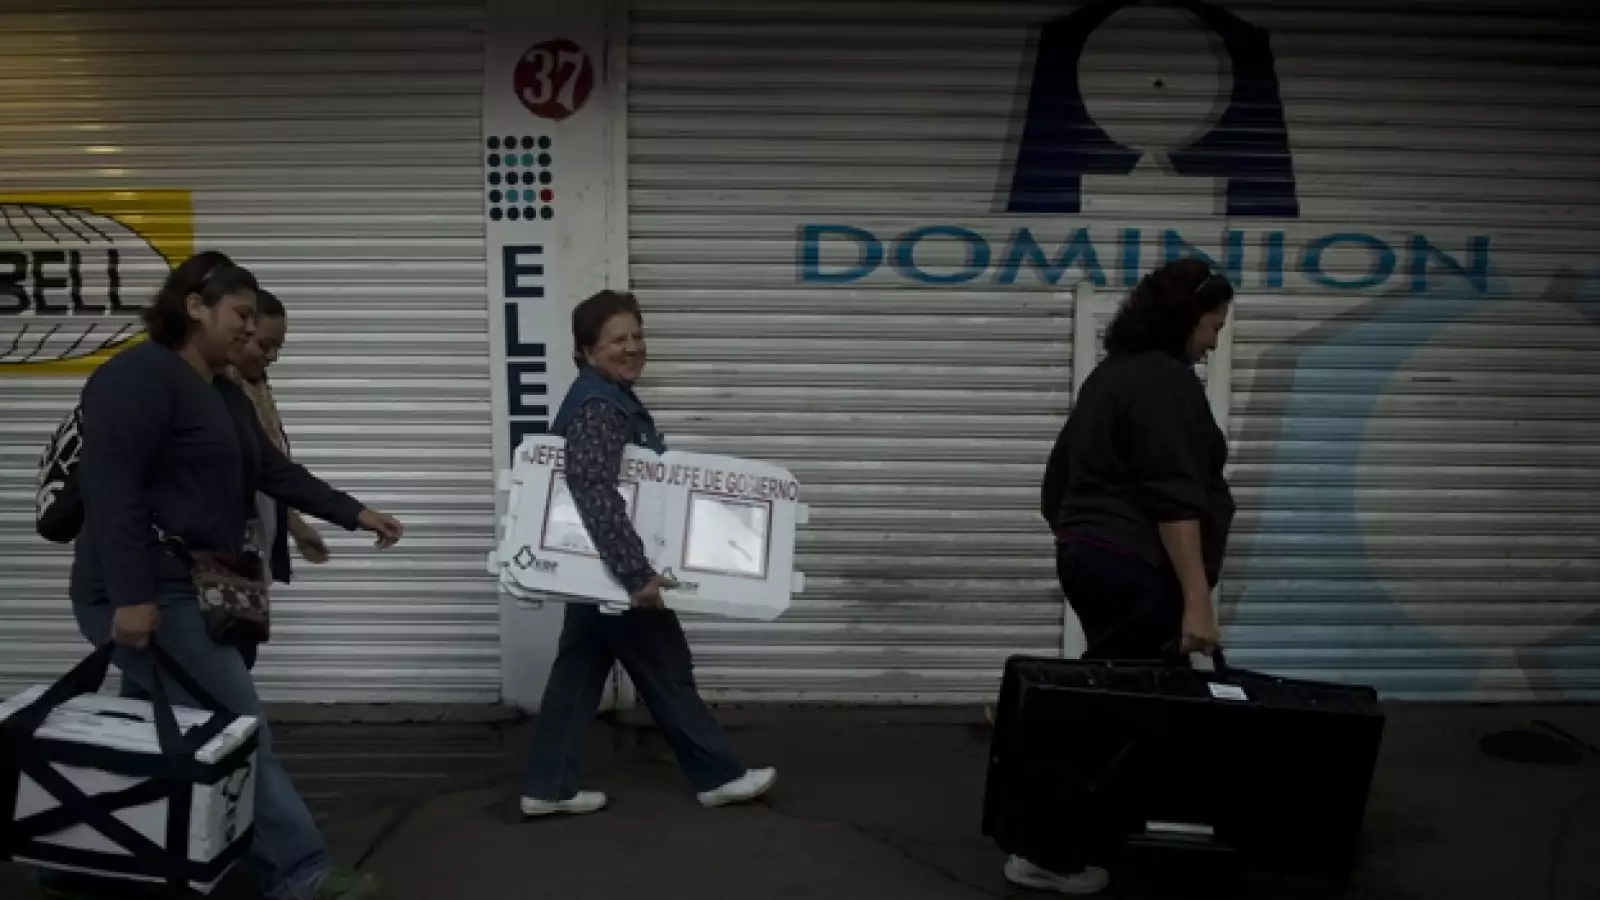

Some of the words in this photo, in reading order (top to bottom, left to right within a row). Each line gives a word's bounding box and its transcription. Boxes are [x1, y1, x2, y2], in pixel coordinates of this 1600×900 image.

[522, 48, 584, 111] 37
[798, 223, 1490, 294] DOMINION
[666, 463, 700, 488] JEFE
[704, 468, 724, 491] DE
